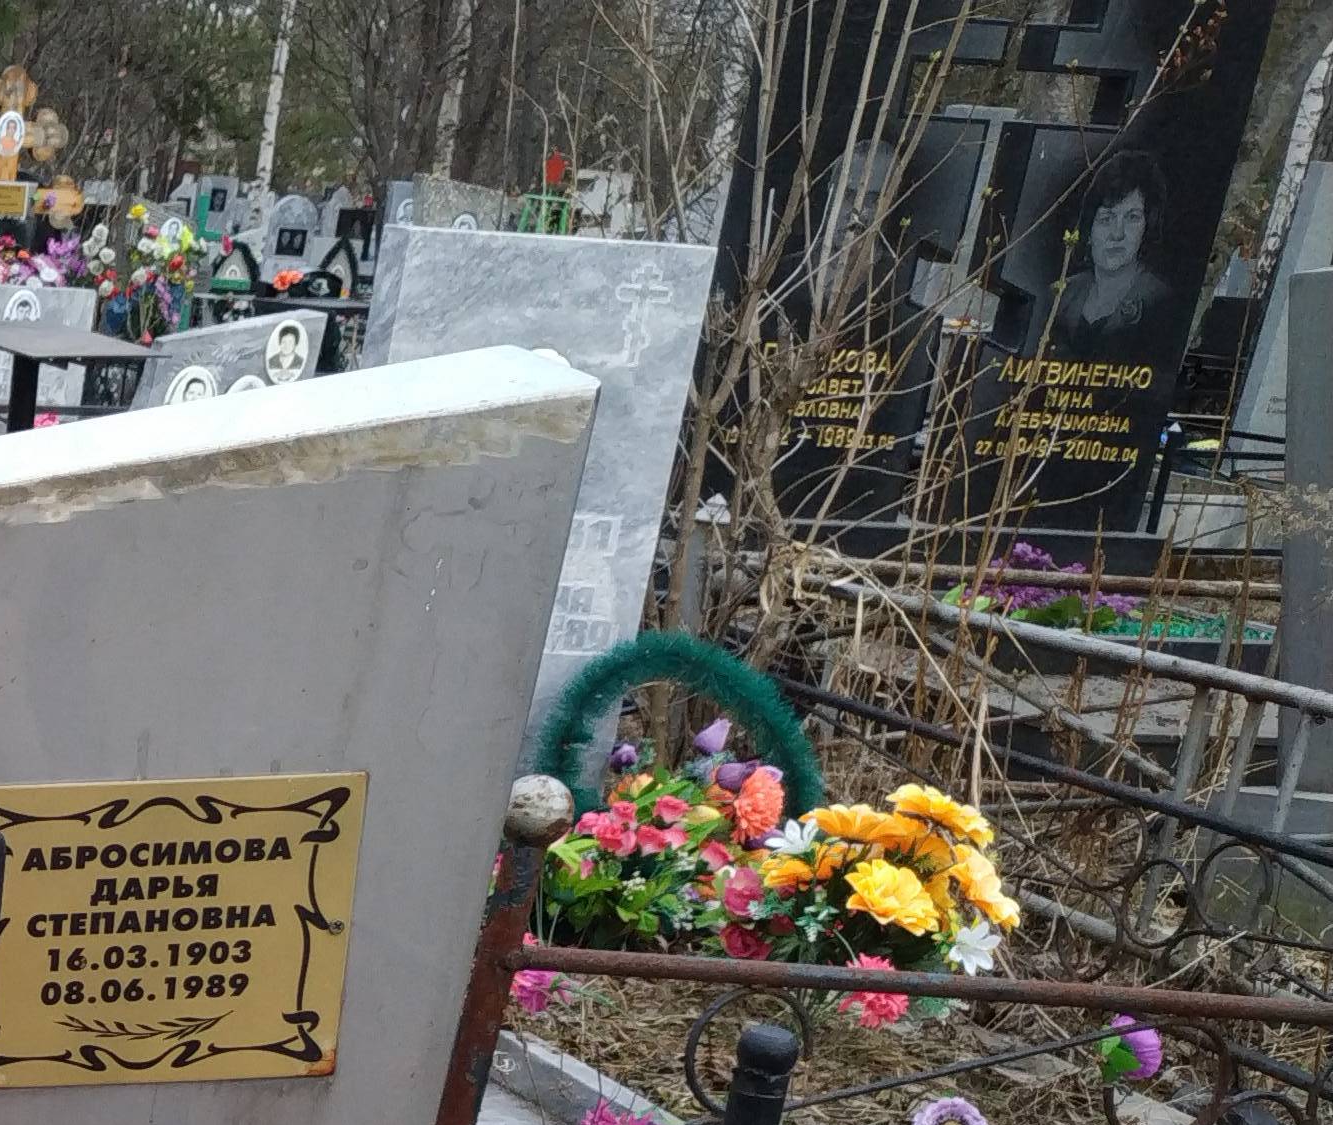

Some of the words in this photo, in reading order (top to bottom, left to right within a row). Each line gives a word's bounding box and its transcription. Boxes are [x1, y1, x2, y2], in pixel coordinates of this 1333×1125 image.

[997, 355, 1154, 390] ЛИТВИНЕНКО
[21, 836, 293, 872] АБРОСИМОВА
[90, 873, 220, 906] ДАРЬЯ
[26, 904, 277, 938] СТЕПАНОВНА
[47, 939, 253, 972] 16.03.1903
[41, 973, 250, 1006] 08.06.1989
